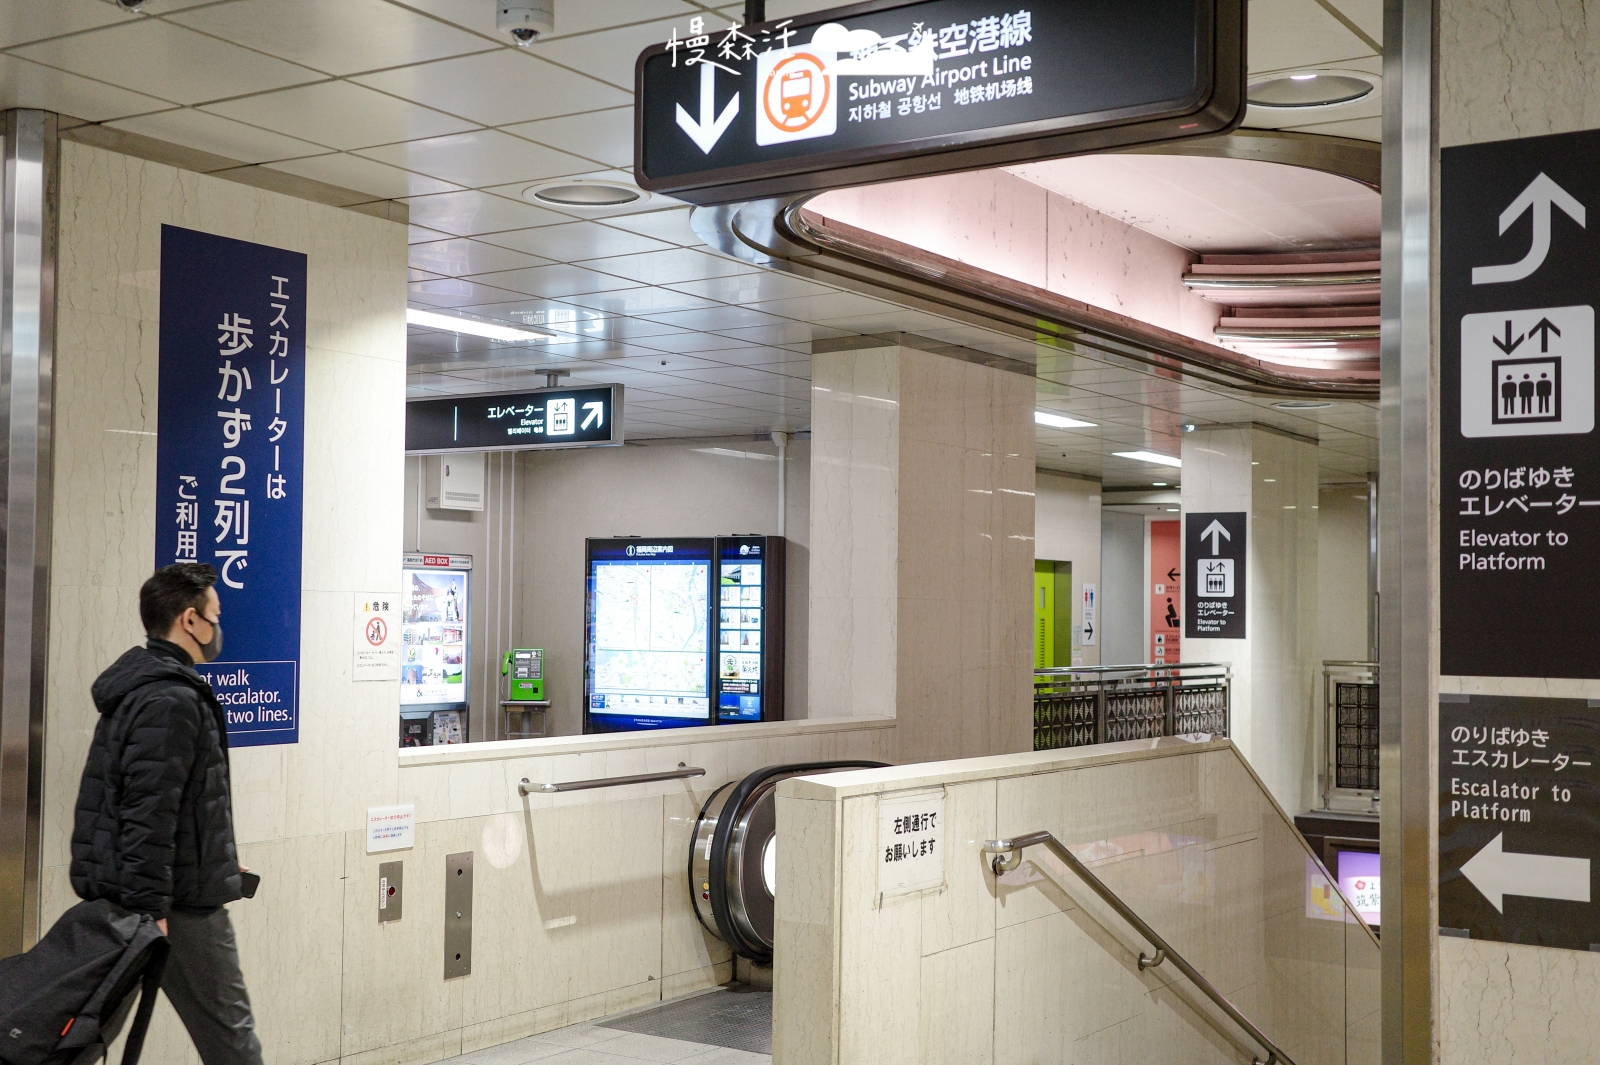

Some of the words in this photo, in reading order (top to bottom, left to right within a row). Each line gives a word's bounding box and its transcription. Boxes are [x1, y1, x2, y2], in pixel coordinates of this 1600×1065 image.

[848, 75, 917, 102] Subway
[921, 60, 988, 88] Airport
[992, 54, 1032, 76] Line
[953, 76, 1034, 106] 地铁机场线
[848, 100, 892, 123] 지하철
[897, 92, 942, 116] 공항선
[266, 275, 290, 500] エスカレーターは
[487, 404, 544, 418] エレベーター
[520, 418, 544, 426] Elevator
[213, 312, 254, 590] 歩かず2列で
[1459, 466, 1575, 490] のりばゆき
[1459, 493, 1600, 516] エレベーター
[175, 475, 198, 564] ご利用
[1459, 529, 1541, 547] Elevator
[1546, 530, 1569, 546] to
[437, 557, 448, 565] BOX
[1459, 552, 1545, 570] Platform
[1197, 601, 1228, 609] のりばゆき
[1197, 609, 1235, 617] エレベーター
[199, 672, 213, 687] ot
[216, 669, 250, 687] walk
[216, 688, 281, 705] escalator.
[227, 709, 254, 724] two
[257, 706, 293, 722] lines.
[1451, 726, 1550, 748] のりばゆき
[1451, 750, 1592, 772] エスカレーター
[1451, 777, 1540, 800] Escalator
[1551, 785, 1571, 802] to
[1451, 800, 1531, 822] Platform
[893, 812, 937, 835] 左側通行で
[885, 838, 936, 863] お願いします
